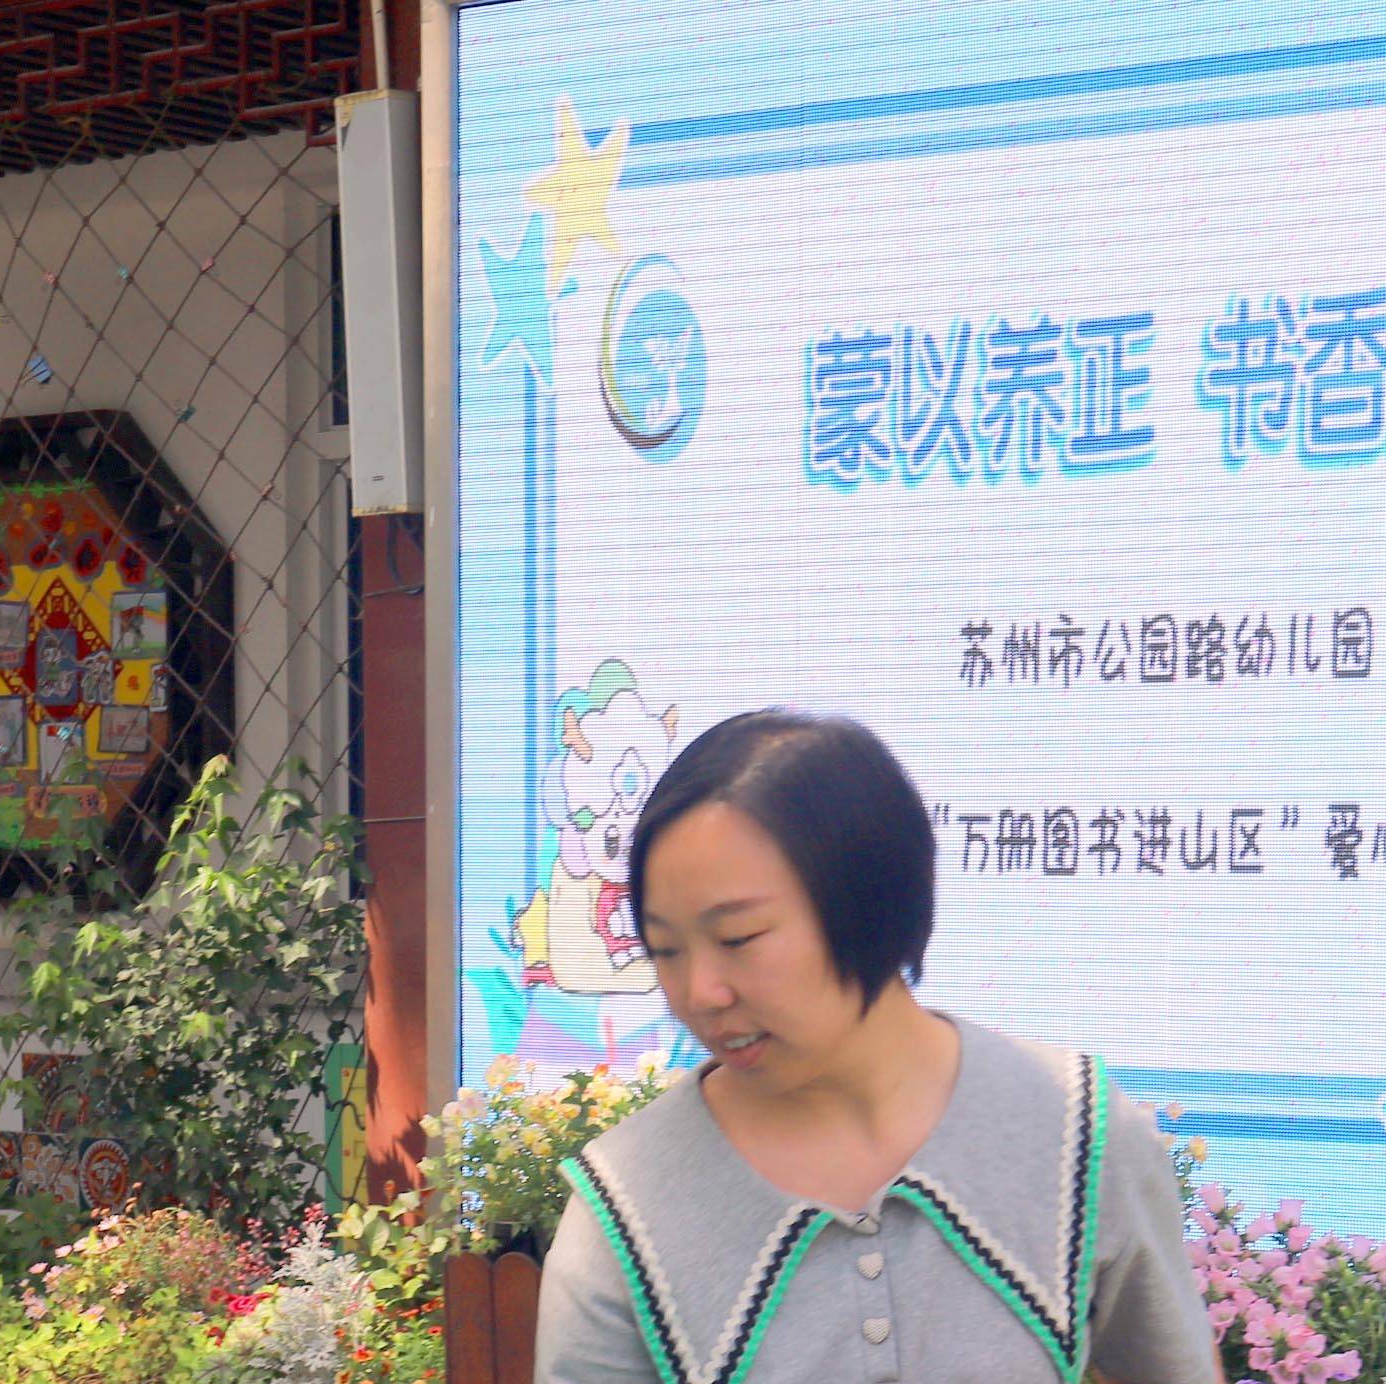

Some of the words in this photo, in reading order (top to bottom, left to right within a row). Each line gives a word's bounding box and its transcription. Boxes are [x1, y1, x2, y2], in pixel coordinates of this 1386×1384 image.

[804, 309, 1157, 491] 蒙以养正
[958, 606, 1373, 688] 苏州市公园路幼儿园
